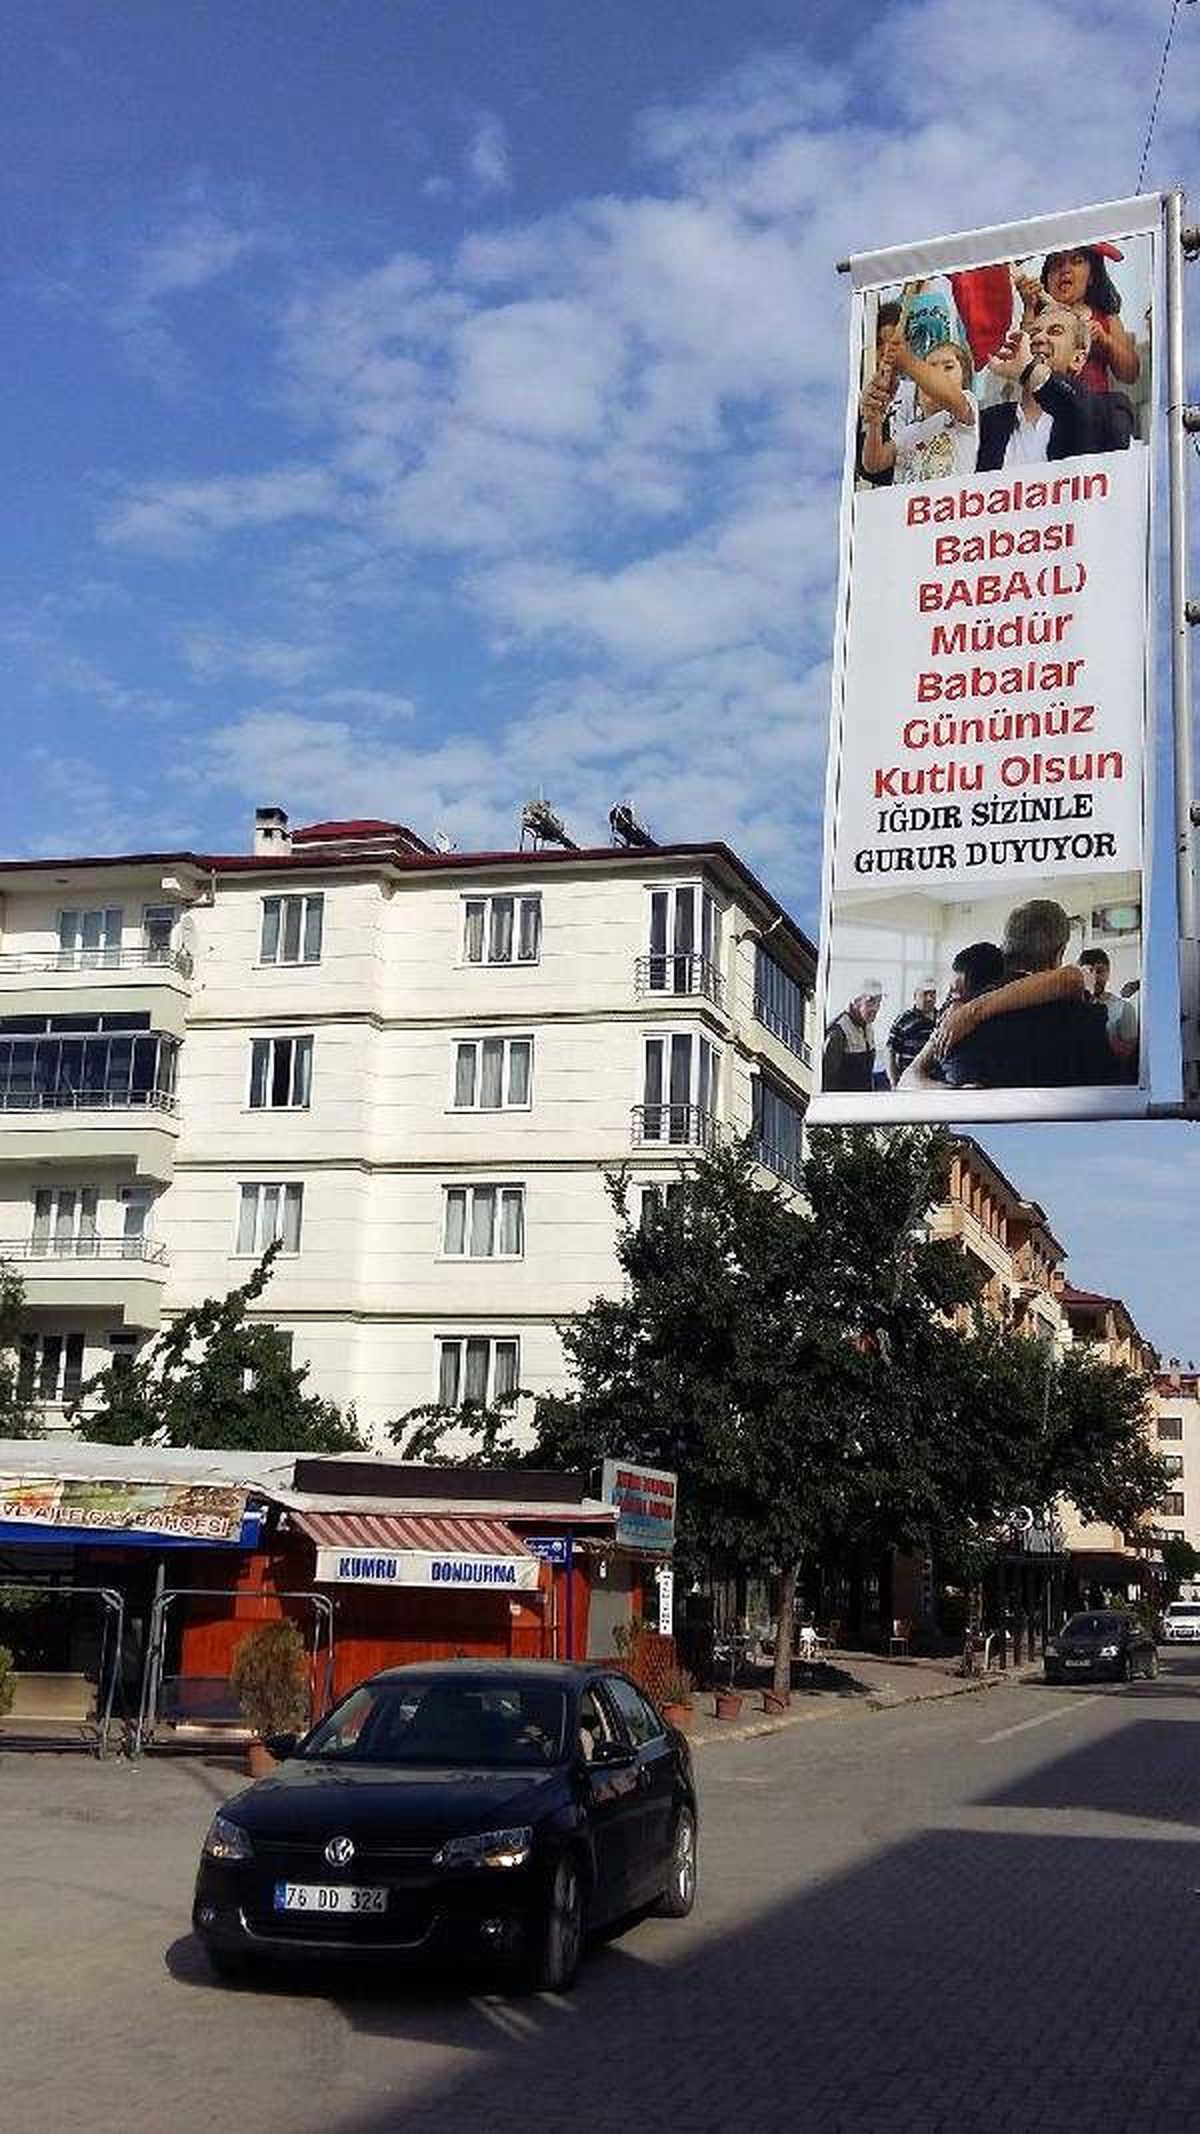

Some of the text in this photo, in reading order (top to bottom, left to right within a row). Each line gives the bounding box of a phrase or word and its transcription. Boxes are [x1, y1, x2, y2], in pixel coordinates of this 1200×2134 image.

[906, 473, 1109, 526] Babaların
[935, 523, 1076, 566] Babası
[919, 565, 1088, 612] BABA(L)
[931, 612, 1073, 656] Müdür
[917, 659, 1085, 703] Babalar
[903, 702, 1096, 749] Gününüz
[874, 752, 1123, 798] Kutlu Olsun
[878, 792, 1092, 833] IĞDIR SİZİNLE
[855, 833, 1116, 873] GURUR DUYUYOR
[339, 1557, 516, 1583] KUMRU DONDURMA
[288, 1887, 306, 1907] 76
[319, 1889, 339, 1909] DD
[351, 1890, 383, 1911] 324
